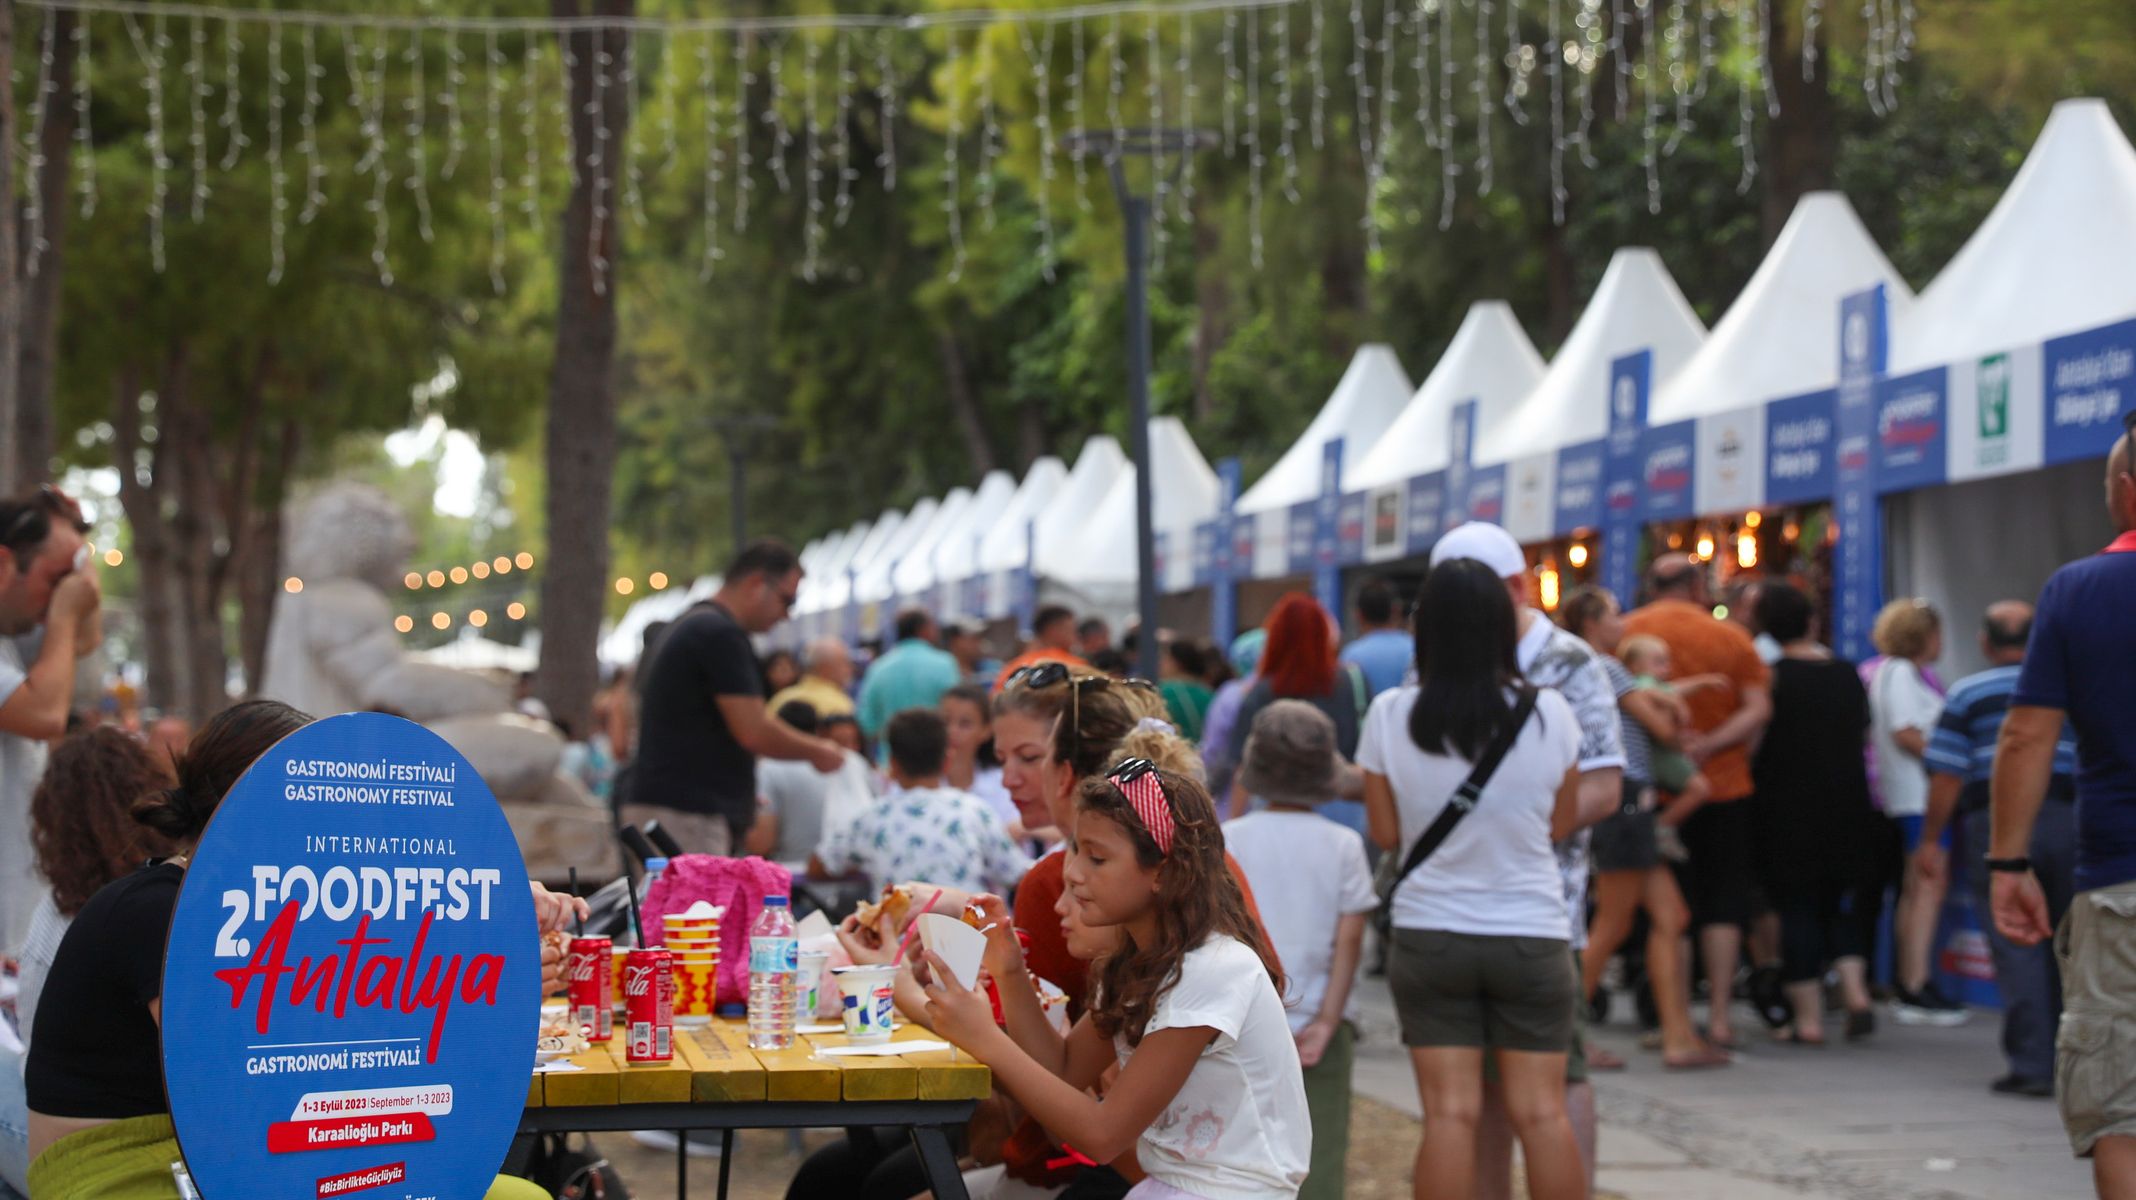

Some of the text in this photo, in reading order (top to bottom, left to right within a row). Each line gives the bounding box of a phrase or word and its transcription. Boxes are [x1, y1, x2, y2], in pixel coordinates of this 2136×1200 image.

[286, 758, 455, 783] GASTRONOMİ FESTİVALİ
[285, 785, 455, 807] GASTRONOMY FESTIVAL
[306, 835, 456, 855] INTERNATIONAL
[214, 865, 500, 957] 2. FOODFEST
[213, 899, 505, 1064] Antalya
[246, 1045, 420, 1075] GASTRONOMİ FESTİVALİ
[303, 1102, 319, 1113] 1-3
[320, 1100, 343, 1114] Eylül
[345, 1098, 367, 1110] 2023
[417, 1094, 429, 1105] 1-3
[431, 1092, 451, 1105] 2023
[308, 1120, 413, 1143] Karaalioğlu Parkı
[319, 1167, 402, 1194] #BizBirlikteGüçlüyüz
